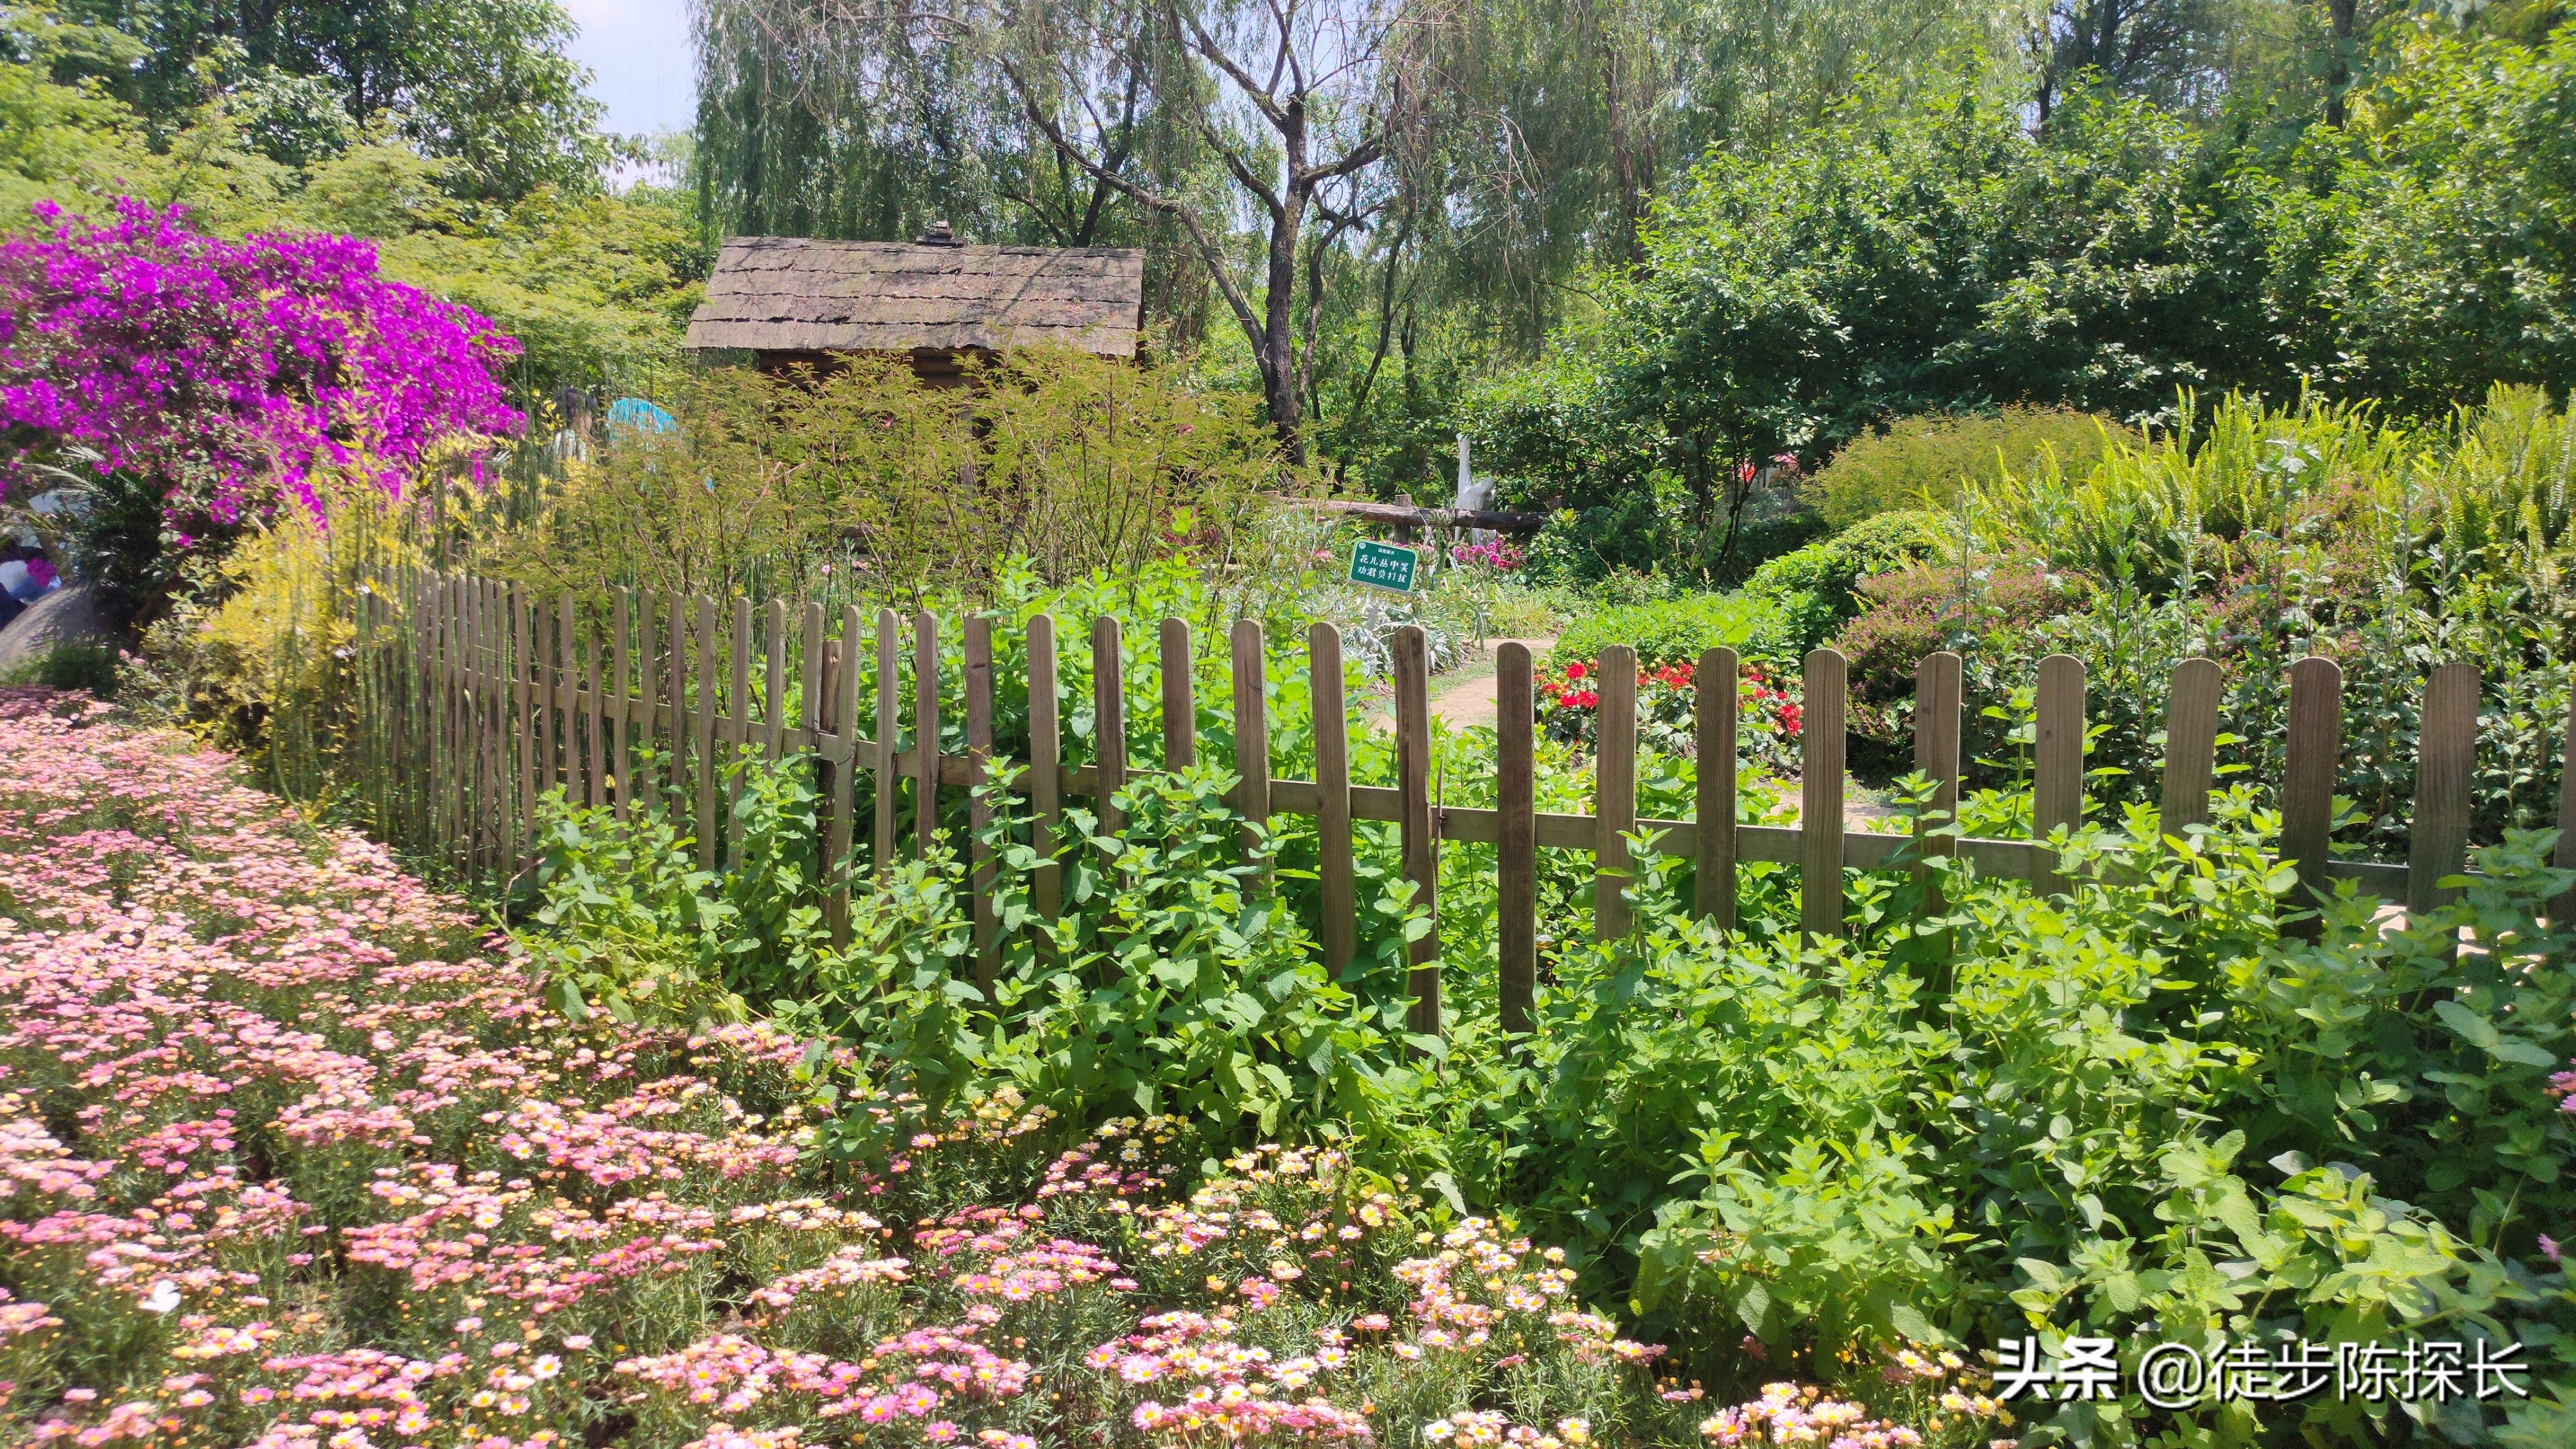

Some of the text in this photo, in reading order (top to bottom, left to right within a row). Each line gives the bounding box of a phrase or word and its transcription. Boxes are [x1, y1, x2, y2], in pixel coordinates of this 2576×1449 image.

[1360, 554, 1409, 572] 花儿丛中笑
[1358, 566, 1406, 582] 劝君莫打扰
